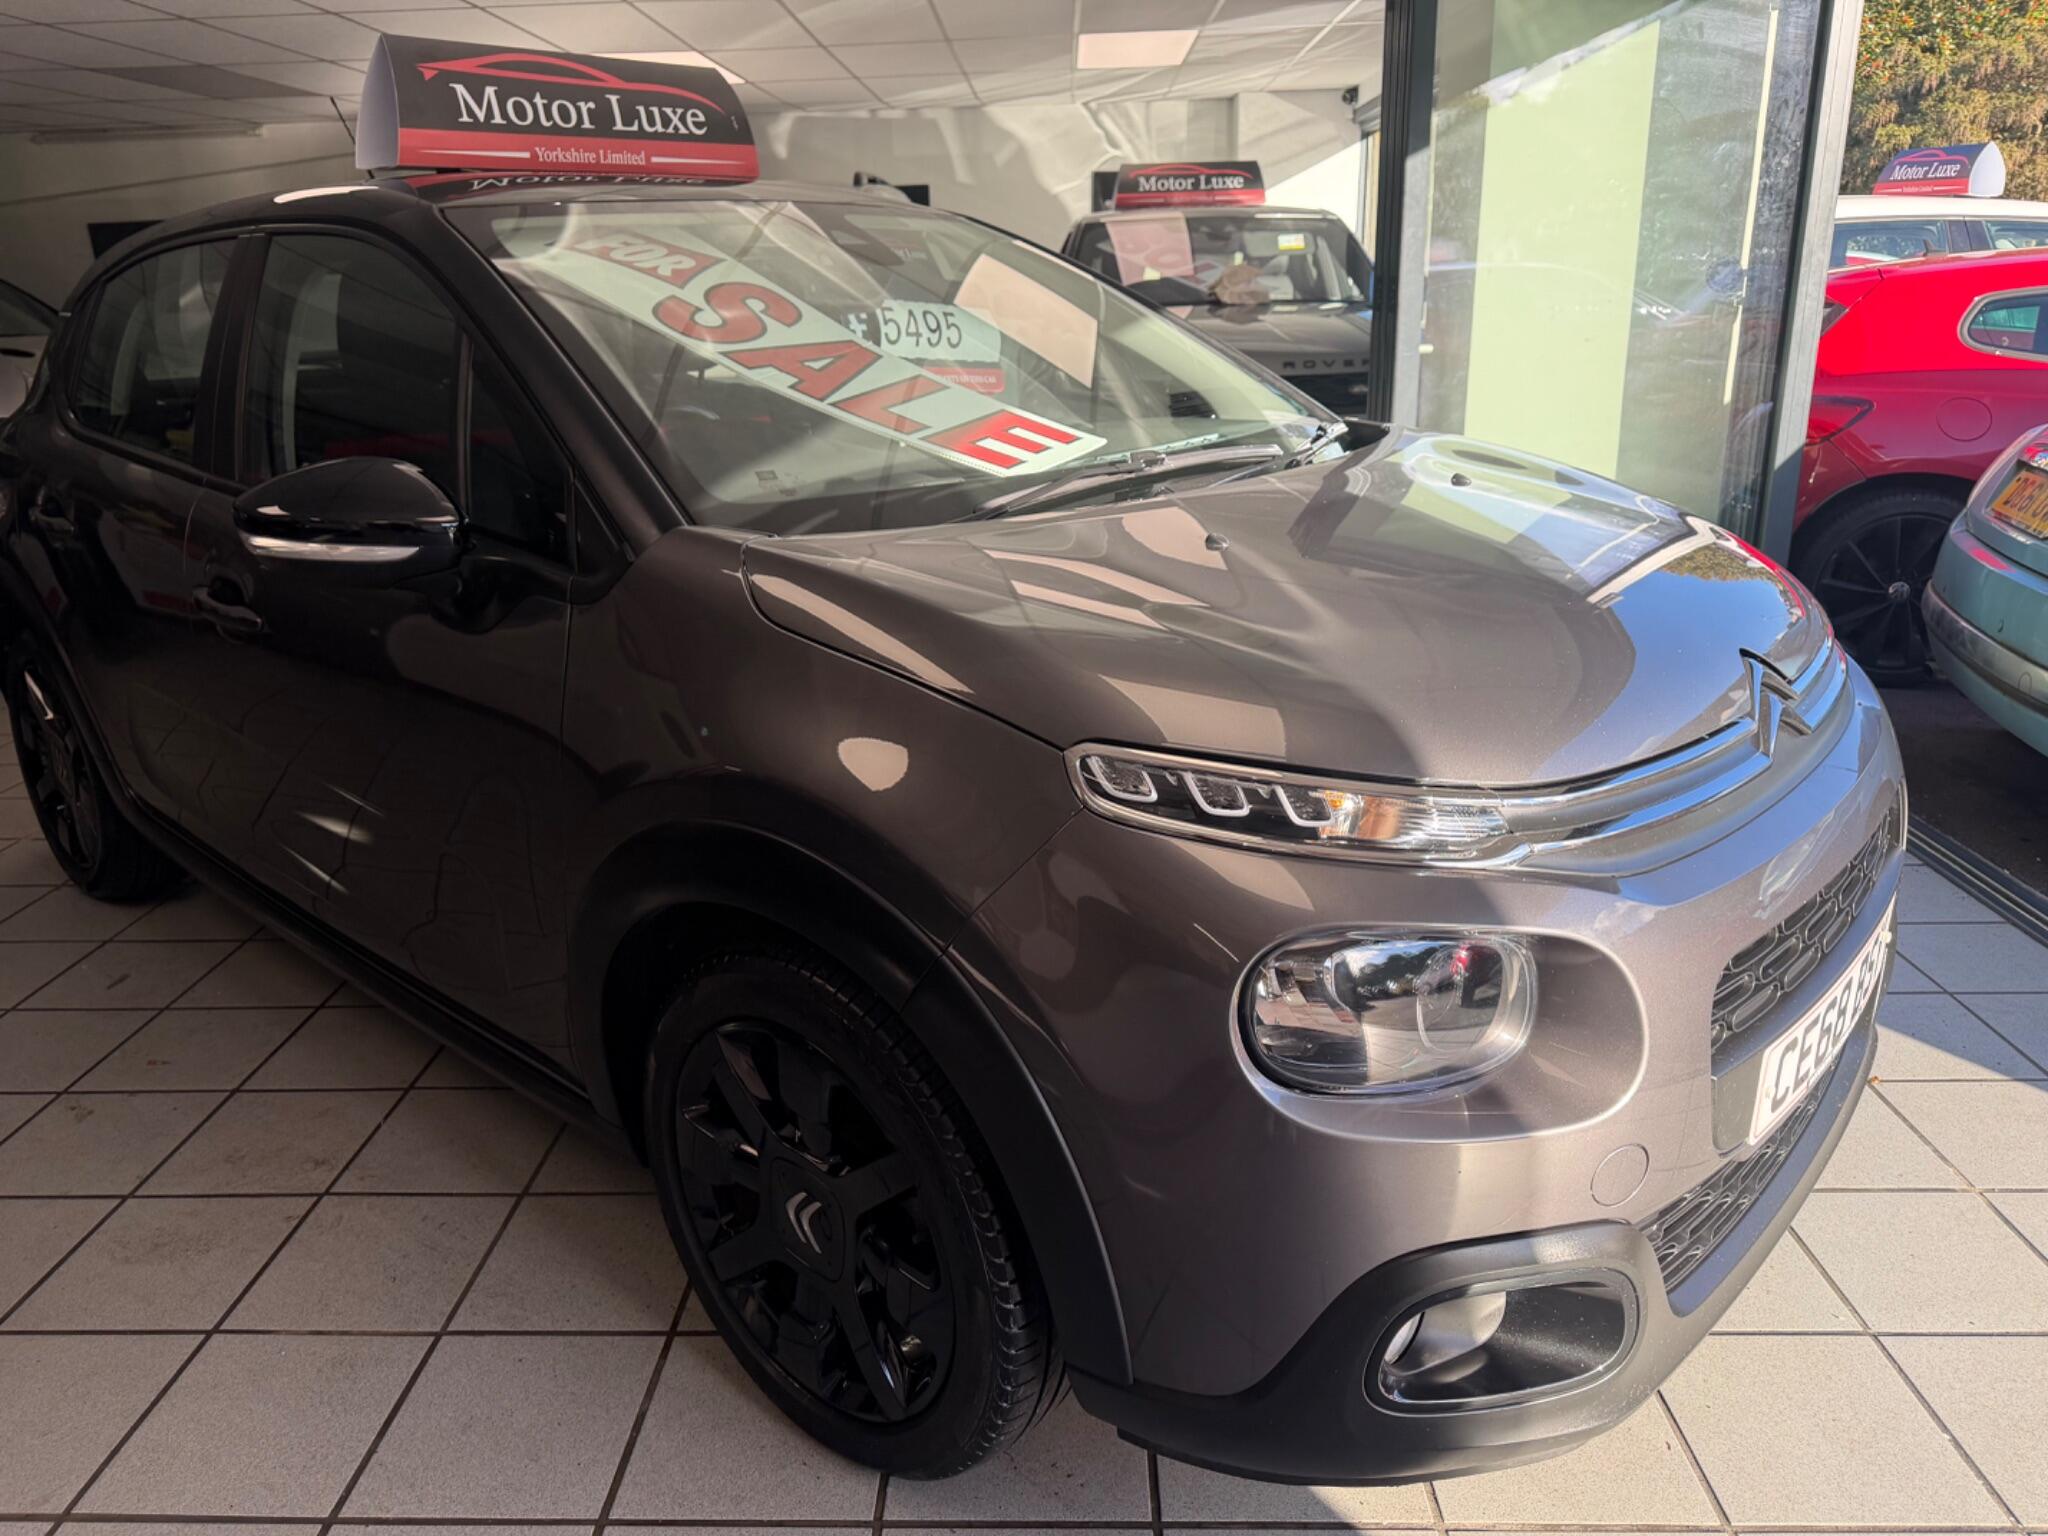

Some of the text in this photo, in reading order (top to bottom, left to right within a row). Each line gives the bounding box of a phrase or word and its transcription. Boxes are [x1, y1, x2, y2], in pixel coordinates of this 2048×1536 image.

[449, 83, 708, 135] Motor Luxe
[535, 148, 646, 165] Yorkshire Limited
[1889, 162, 1961, 180] Motor Luxe
[1137, 174, 1244, 192] Motor Luxe
[578, 233, 697, 277] FOR
[652, 281, 1083, 470] SALE
